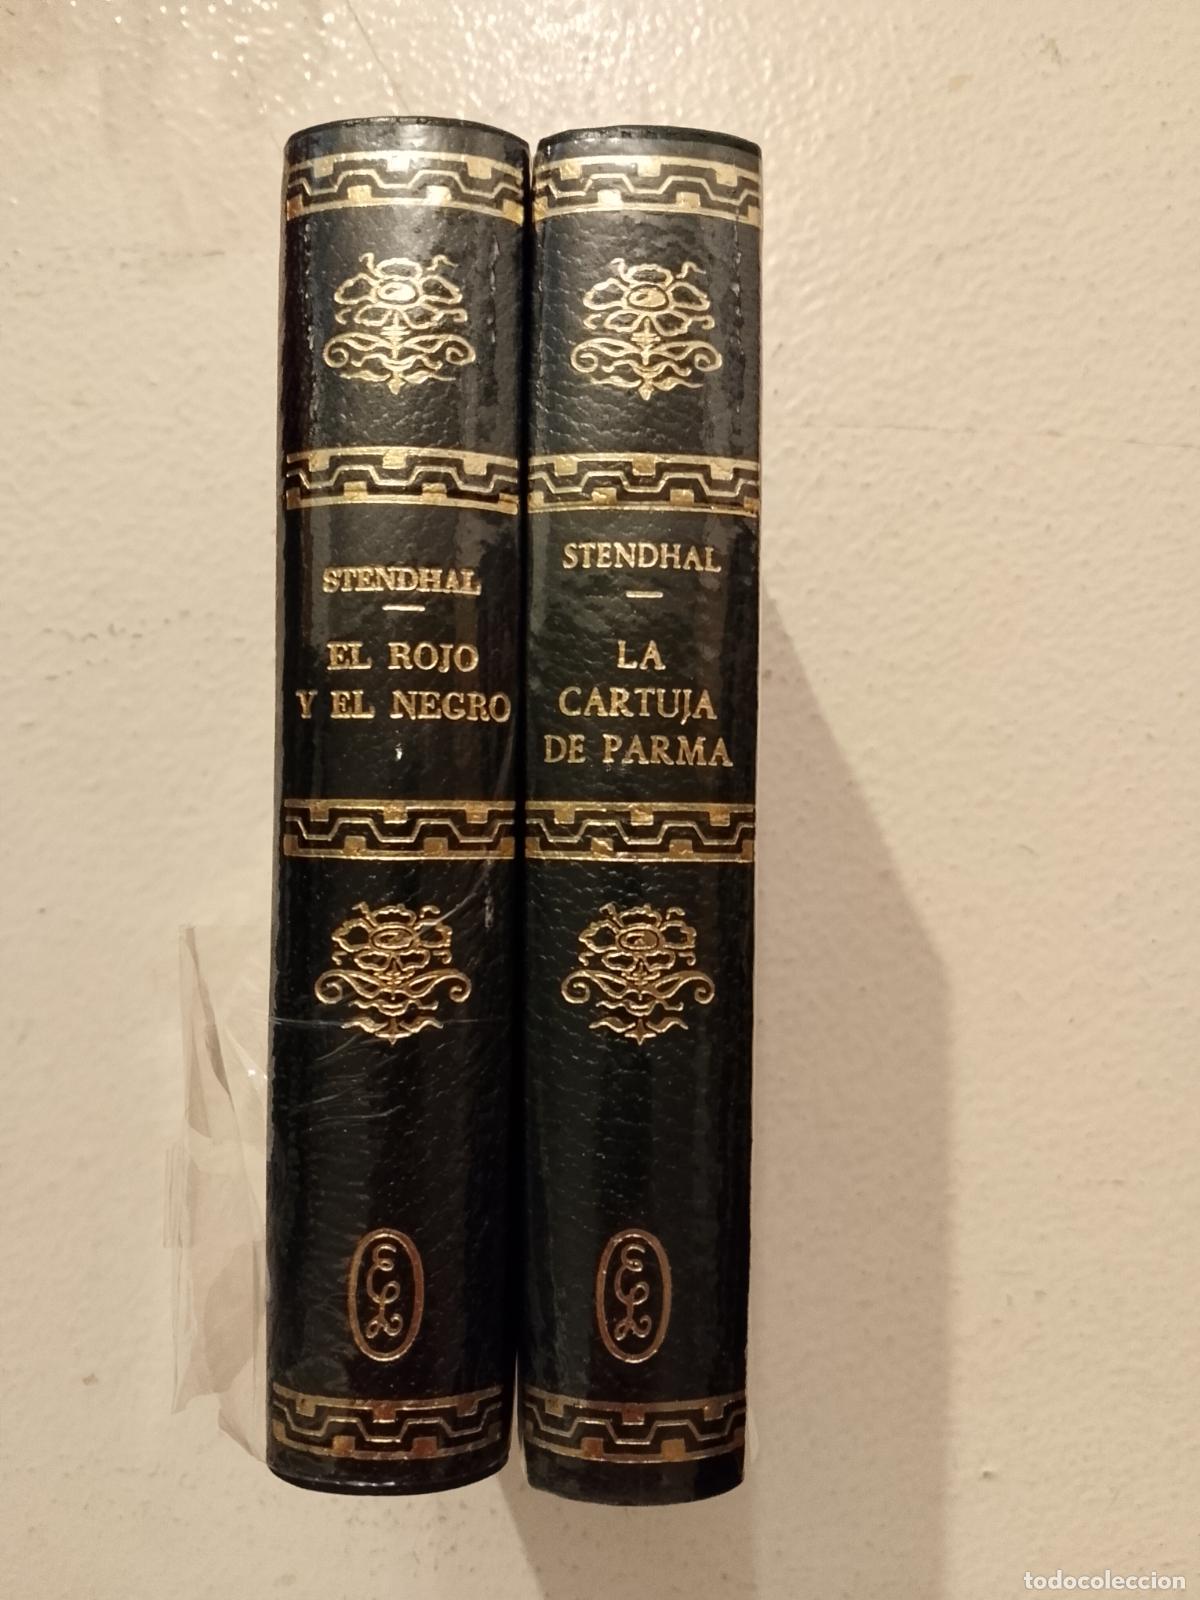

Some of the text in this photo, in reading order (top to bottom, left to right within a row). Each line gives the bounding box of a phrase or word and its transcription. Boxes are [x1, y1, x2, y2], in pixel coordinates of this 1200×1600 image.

[562, 542, 722, 572] STENDHAL
[322, 565, 482, 595] STENDHAL
[327, 641, 479, 673] EL ROJO
[617, 640, 666, 670] LA
[296, 690, 511, 722] Y EL NEGRO
[558, 686, 717, 725] CARTUJA
[544, 734, 734, 767] DE PARMA
